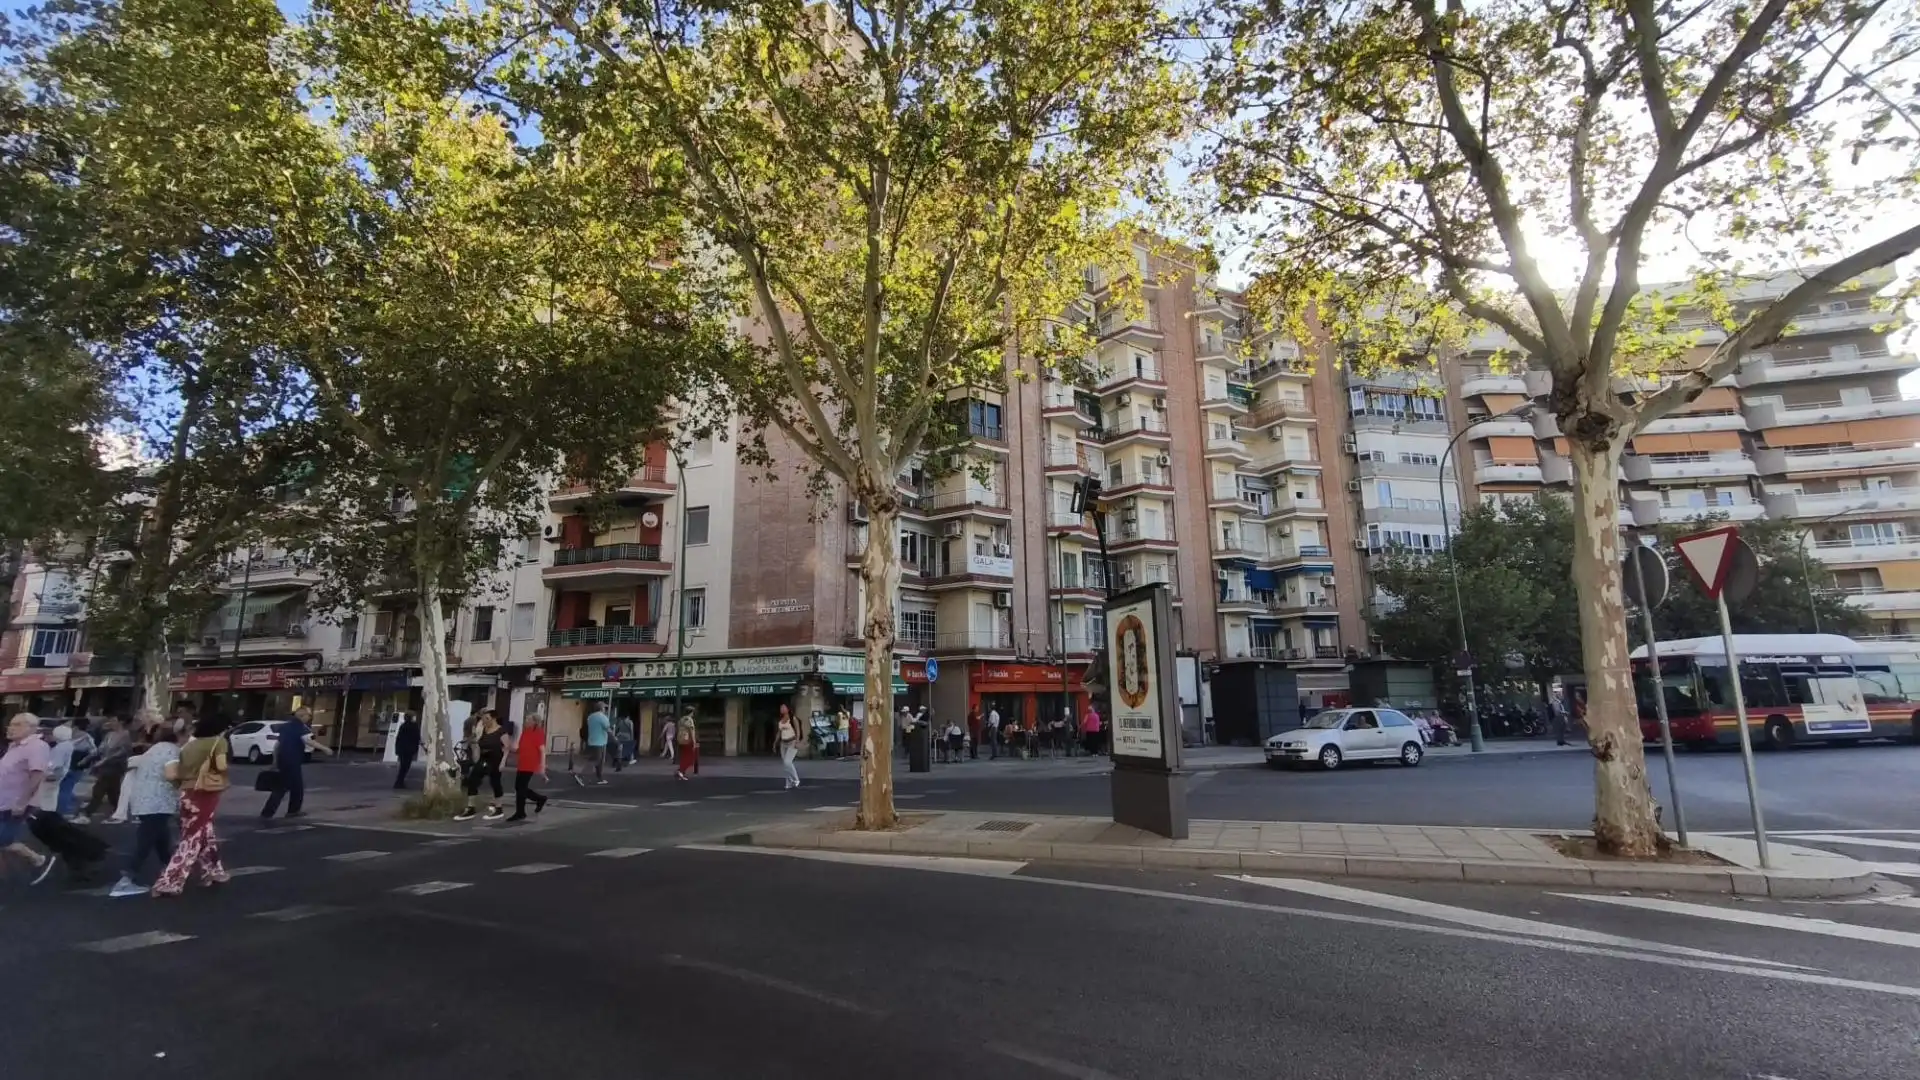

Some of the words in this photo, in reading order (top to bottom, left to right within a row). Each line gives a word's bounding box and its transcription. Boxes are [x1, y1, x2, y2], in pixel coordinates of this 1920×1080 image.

[973, 556, 994, 566] GALA
[645, 660, 736, 676] PRADERA
[309, 675, 356, 688] MONTECAO
[655, 688, 689, 697] DESAYOS
[737, 685, 774, 695] PASTELERIA
